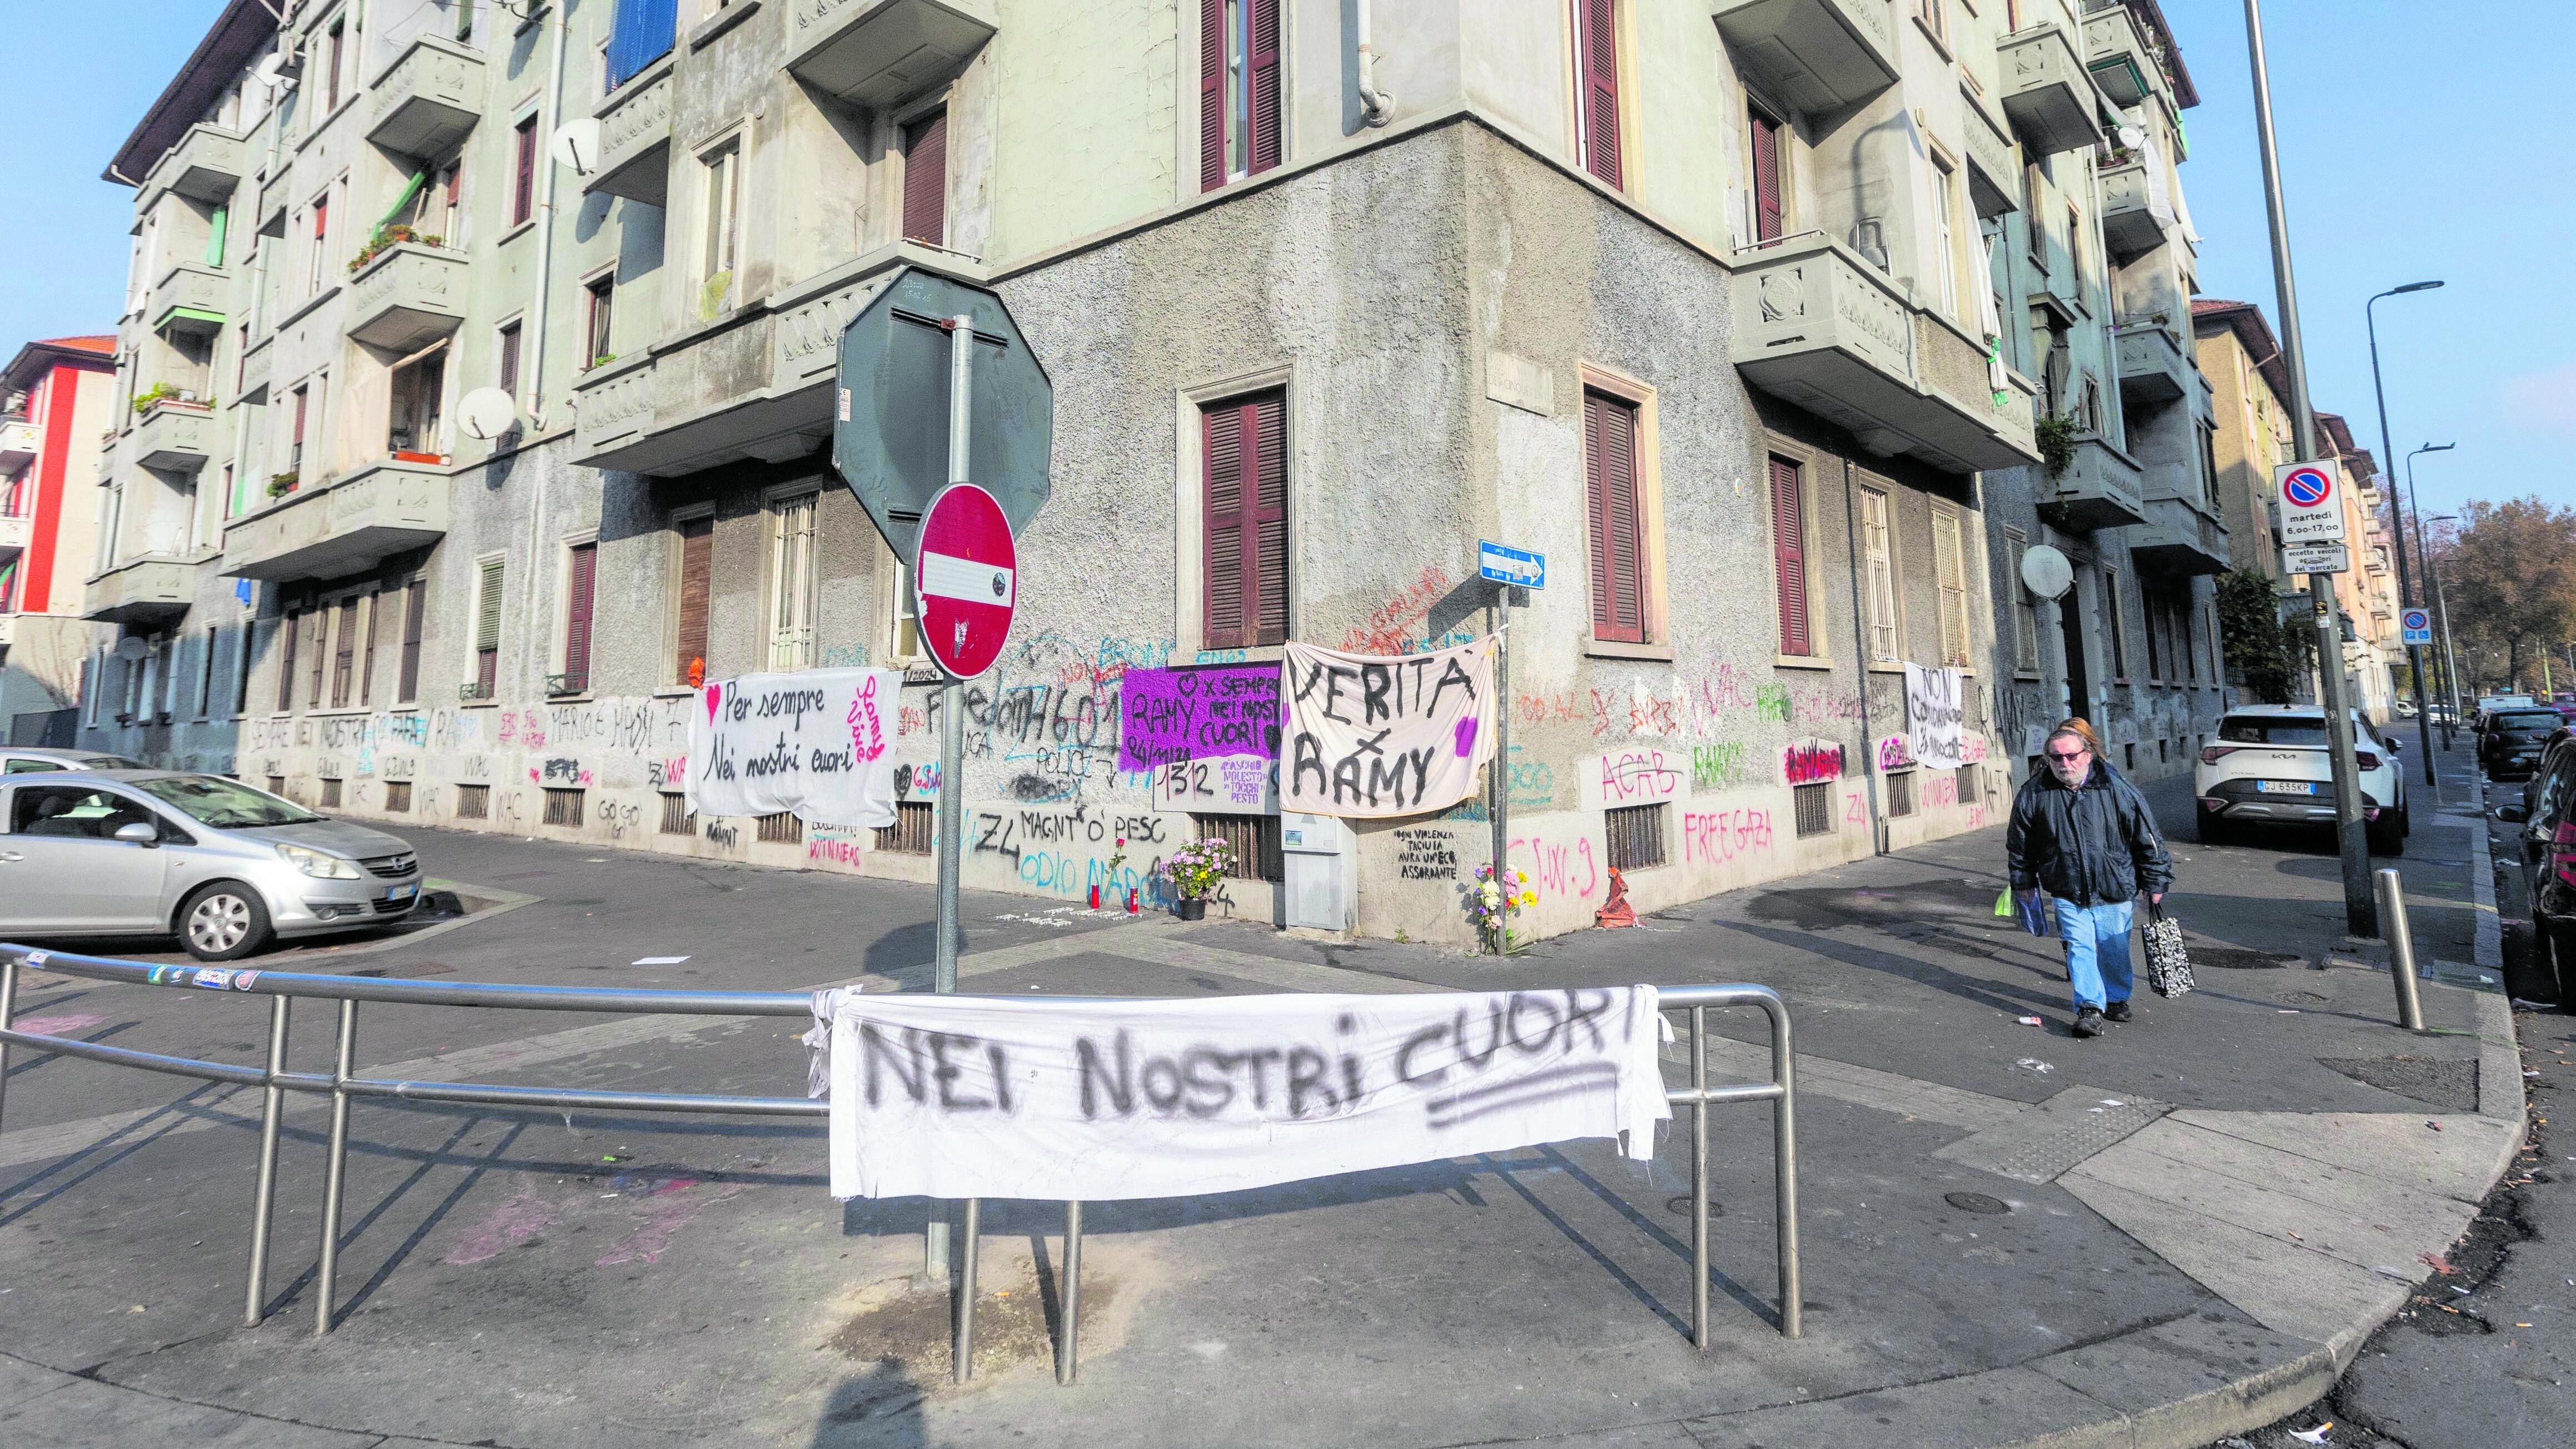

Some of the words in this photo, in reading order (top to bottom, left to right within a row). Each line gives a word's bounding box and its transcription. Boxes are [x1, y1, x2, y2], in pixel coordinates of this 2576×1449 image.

[725, 680, 753, 722] Per
[756, 689, 825, 732] sempre
[1923, 668, 1952, 706] NON
[551, 706, 592, 748] MARIO
[1131, 693, 1196, 740] RAMY
[1200, 720, 1259, 750] CUORI
[703, 732, 735, 782] Nei
[745, 731, 800, 777] nostri
[811, 742, 854, 773] cuori
[1224, 771, 1263, 783] MOLESTO
[1292, 731, 1435, 809] RAMY
[1602, 748, 1675, 801] ACAB
[1231, 782, 1259, 793] TOCCHI
[1231, 792, 1259, 805] PESTO
[1115, 816, 1167, 844] PESC
[1414, 829, 1454, 840] VIOLENZA
[1684, 810, 1733, 864] FREE
[1732, 807, 1774, 857] GAZA
[1020, 850, 1077, 894] ODIO
[1401, 865, 1457, 880] ASSORDANTE
[857, 1022, 1014, 1114] NEI
[1396, 984, 1637, 1088] CUORI
